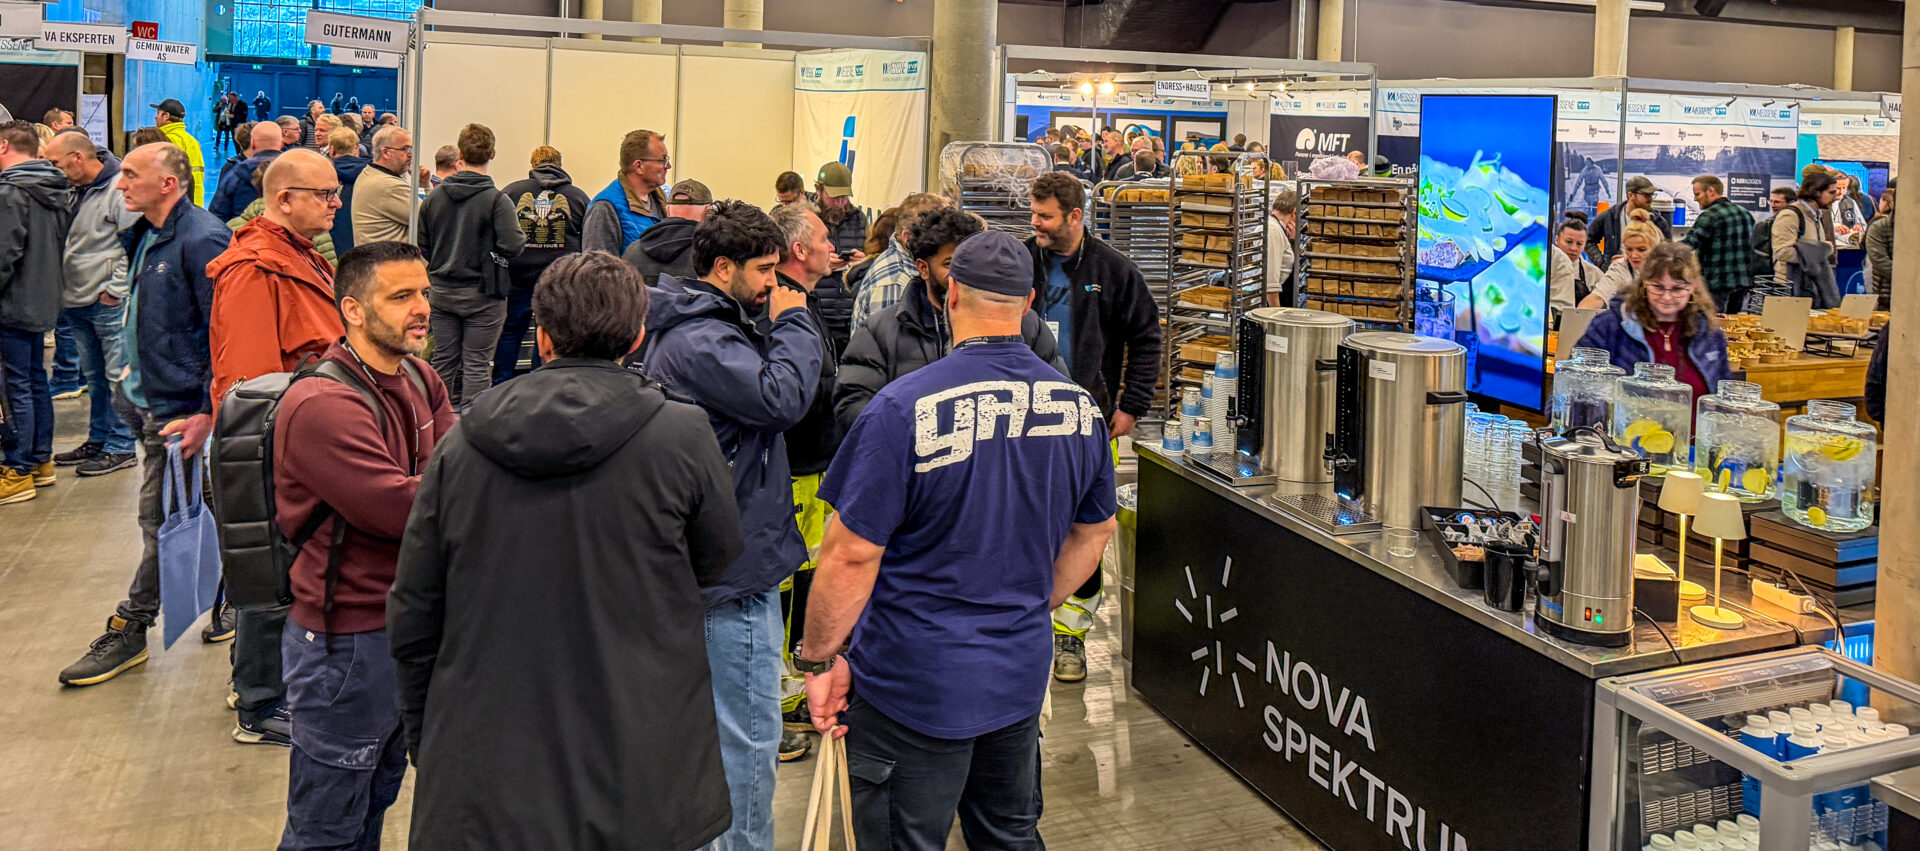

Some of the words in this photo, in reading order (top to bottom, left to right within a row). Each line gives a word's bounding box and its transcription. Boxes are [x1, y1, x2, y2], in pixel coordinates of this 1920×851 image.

[44, 31, 57, 42] VA
[60, 32, 115, 45] EKSPERTEN
[137, 26, 156, 39] WC
[323, 23, 392, 42] GUTERMANN
[135, 41, 163, 52] GEMINI
[165, 44, 190, 55] WATER
[354, 50, 378, 60] WAVIN
[157, 53, 167, 61] AS
[1318, 132, 1351, 153] MFT
[1392, 164, 1404, 174] En
[1265, 639, 1376, 752] NOVA
